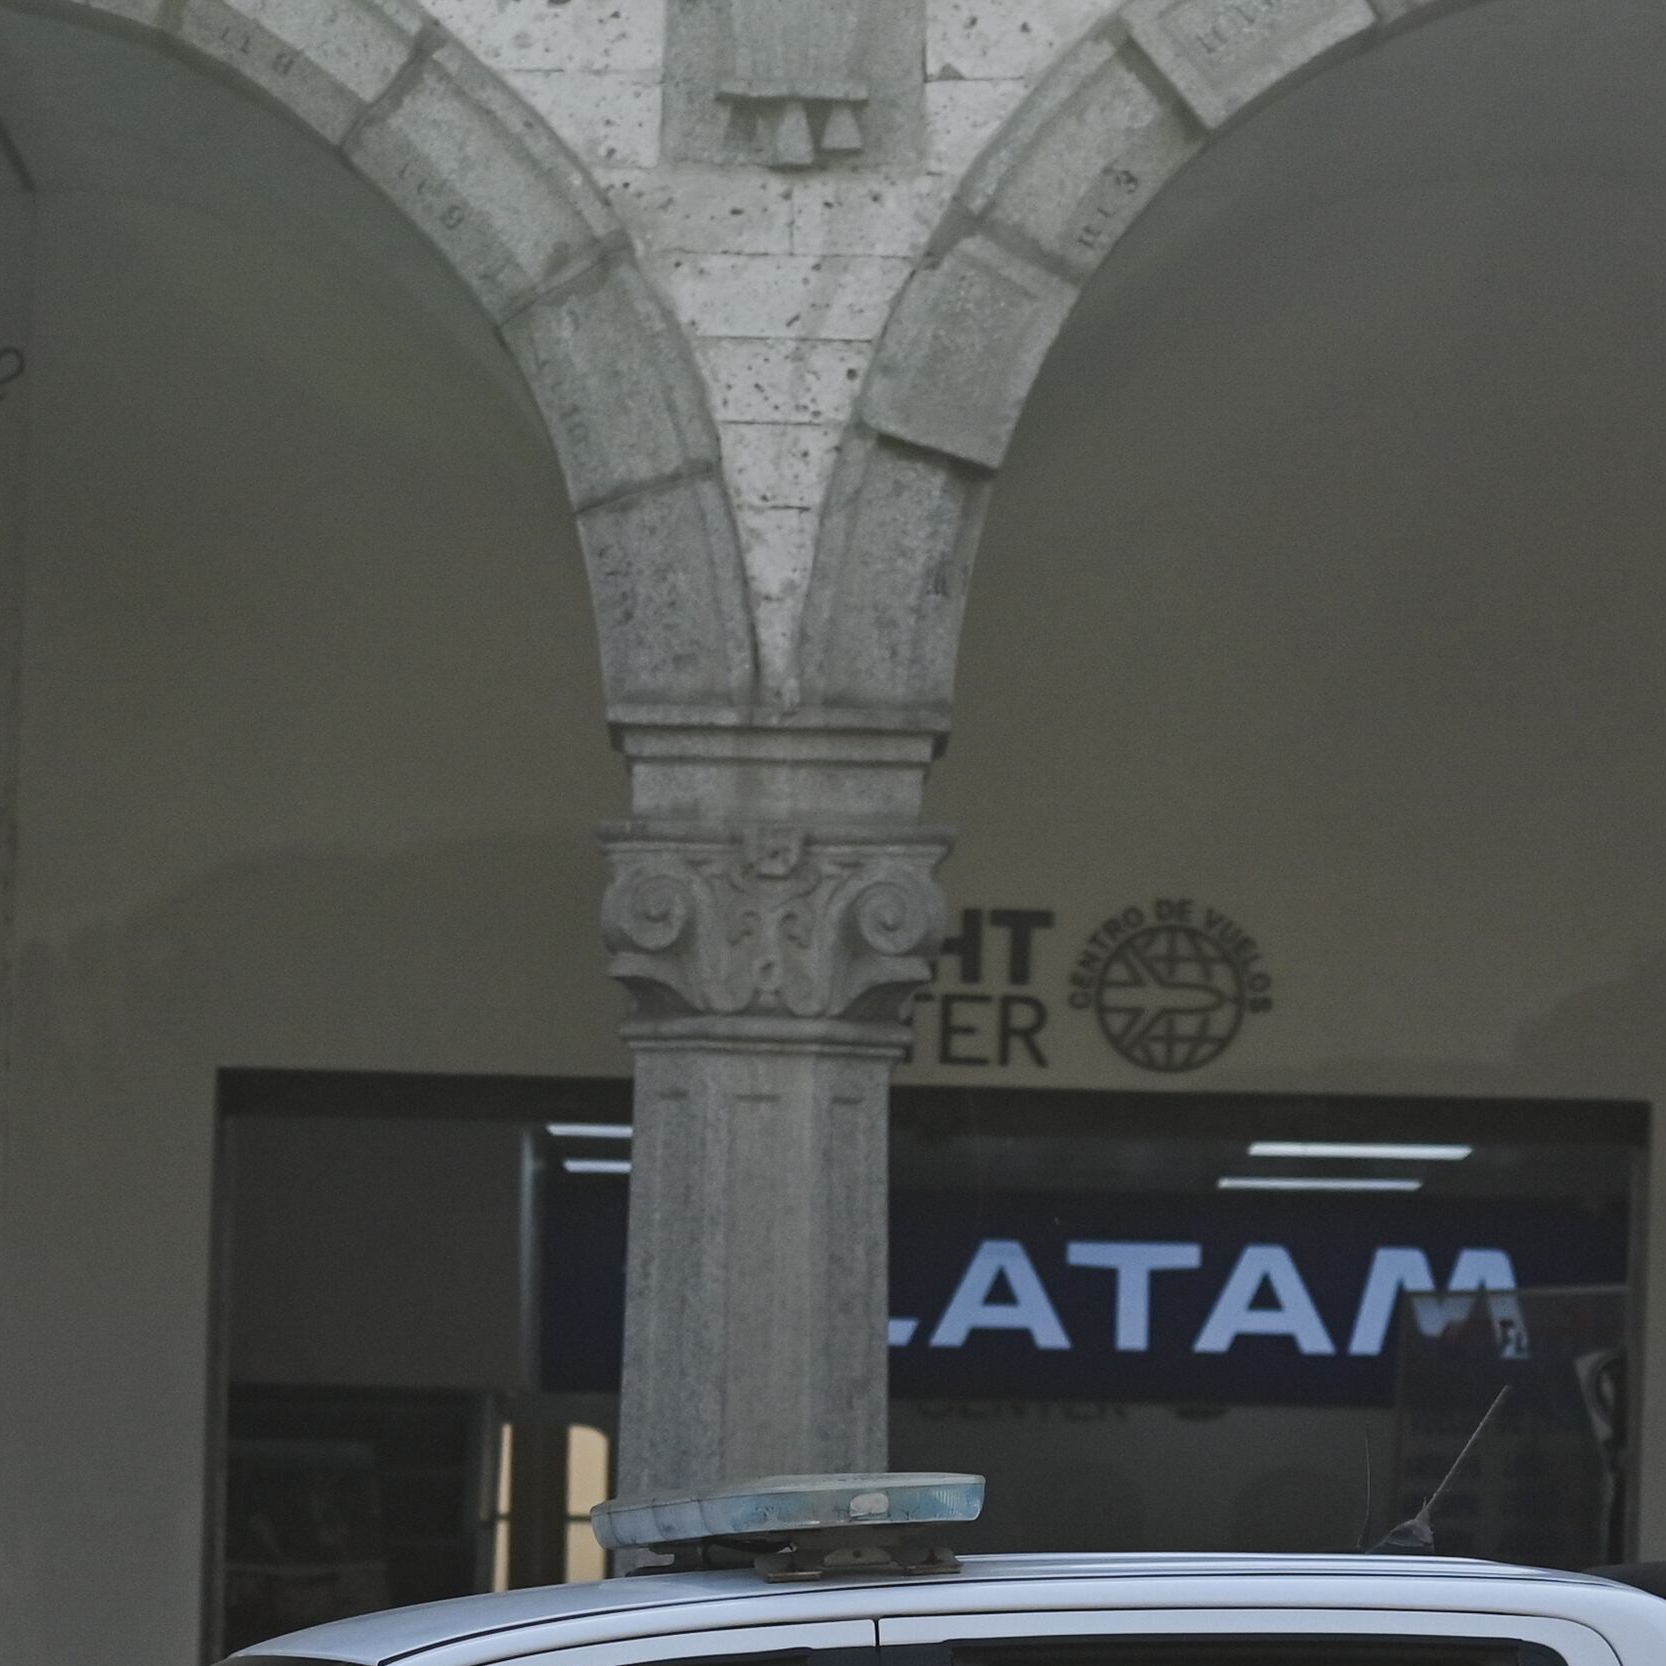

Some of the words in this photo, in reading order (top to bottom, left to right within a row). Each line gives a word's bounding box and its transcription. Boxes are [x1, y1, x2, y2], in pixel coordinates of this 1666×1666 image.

[1068, 906, 1146, 1010] CENTRO
[1154, 898, 1195, 922] DE
[1204, 907, 1275, 1014] VUELOS
[888, 1239, 1530, 1359] ATAM
